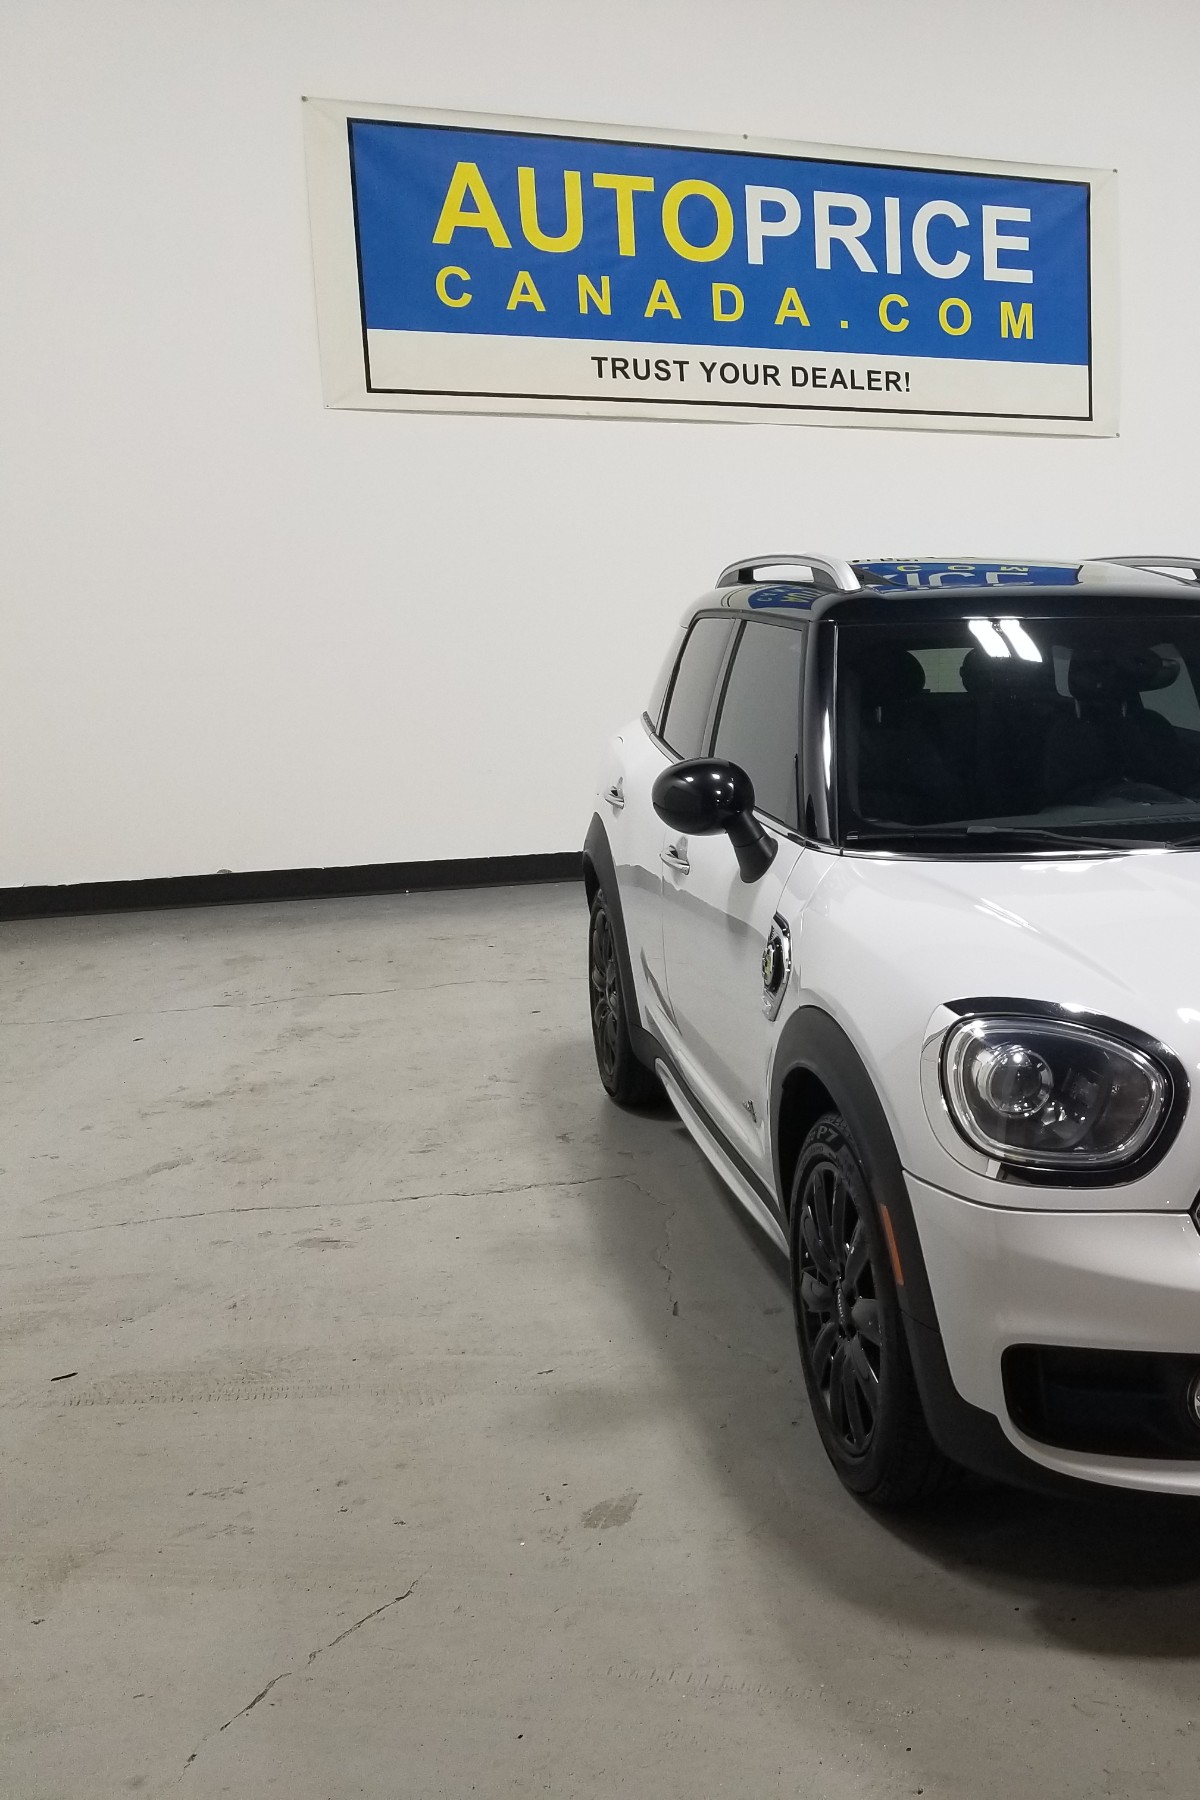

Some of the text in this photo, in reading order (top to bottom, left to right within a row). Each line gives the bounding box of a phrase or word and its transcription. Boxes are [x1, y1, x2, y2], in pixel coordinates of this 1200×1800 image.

[432, 161, 1034, 284] AUTOPRICE
[435, 265, 1034, 340] CANADA.COM
[590, 356, 910, 393] TRUST YOUR DEALER!
[816, 1125, 839, 1142] P7
